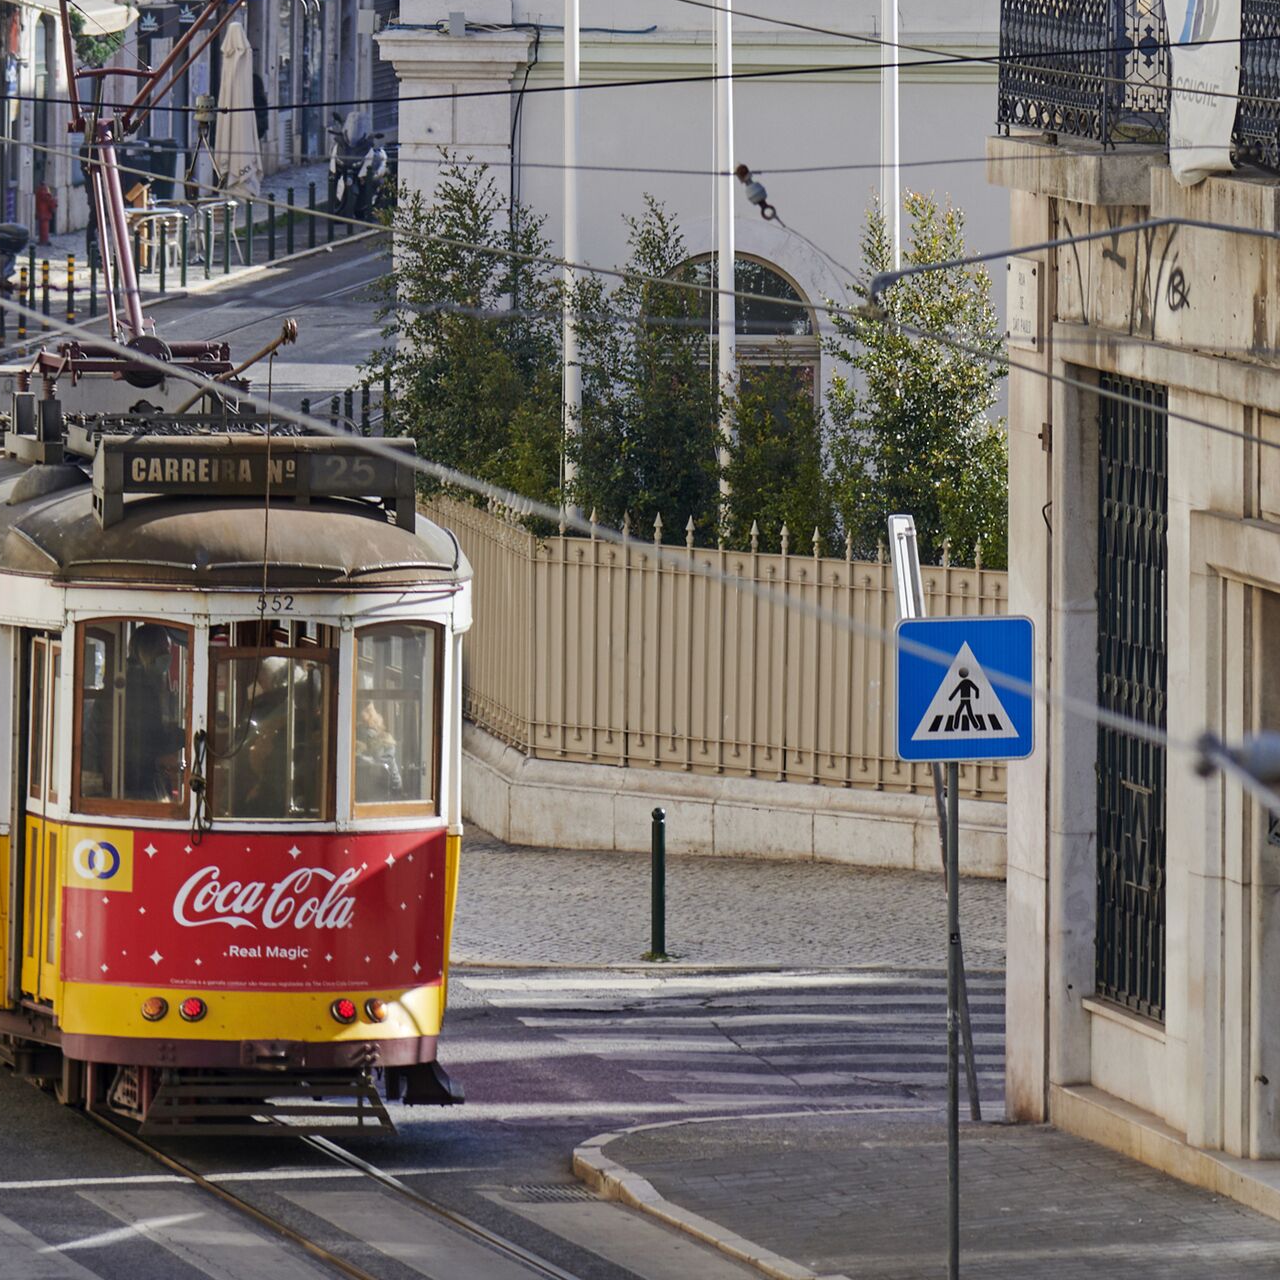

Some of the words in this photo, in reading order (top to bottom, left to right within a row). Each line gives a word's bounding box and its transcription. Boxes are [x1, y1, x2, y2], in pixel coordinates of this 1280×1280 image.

[1174, 76, 1220, 108] COUCHE
[132, 457, 252, 483] CARREIRA
[324, 455, 377, 486] 25
[256, 595, 294, 612] 552
[229, 945, 261, 958] Real
[266, 945, 309, 960] Magic
